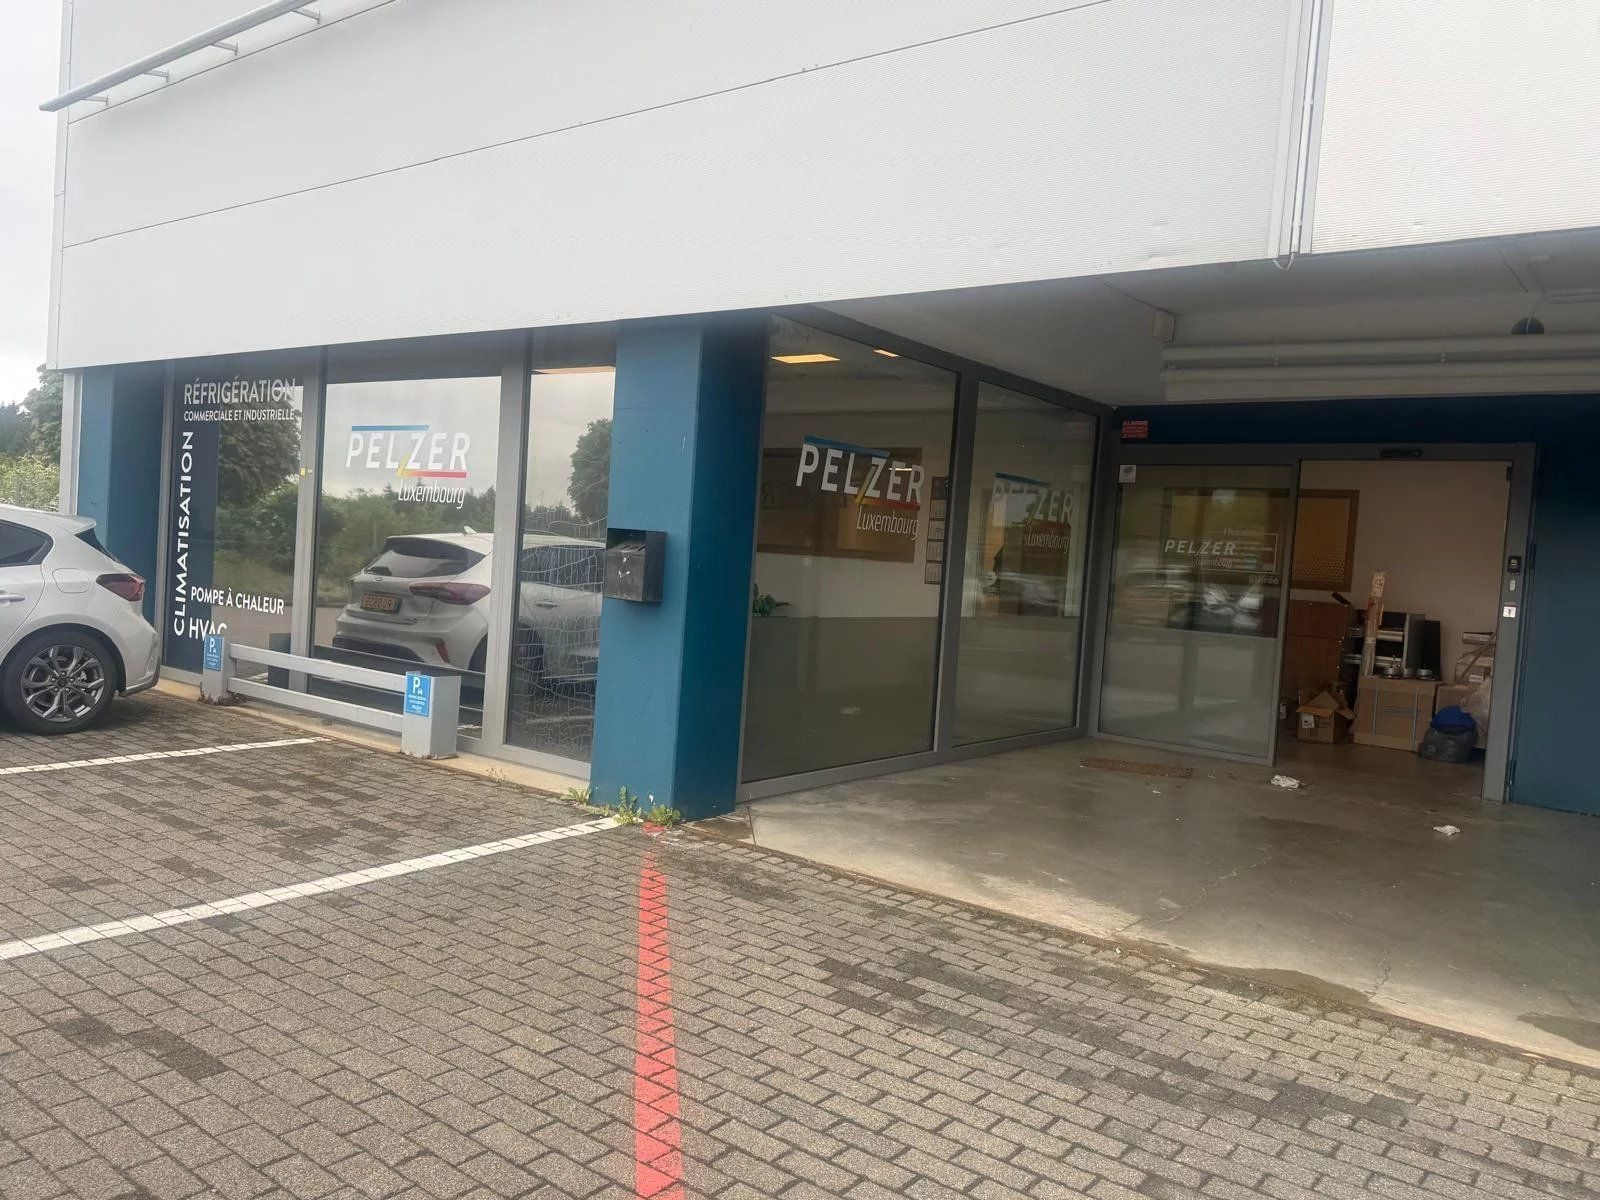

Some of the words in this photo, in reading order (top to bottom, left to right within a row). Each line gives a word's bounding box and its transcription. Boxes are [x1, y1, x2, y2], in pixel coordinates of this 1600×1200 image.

[184, 375, 296, 404] RÉFRIGÉRATION
[183, 410, 233, 422] COMMERCIALE
[233, 410, 242, 421] ET
[243, 408, 295, 421] INDUSTRIELLE
[345, 432, 471, 471] PELZER
[795, 443, 925, 505] PELZER
[398, 479, 465, 509] Luxembourg
[991, 480, 1073, 525] PZER
[174, 431, 194, 636] CLIMATISATION
[856, 505, 920, 541] Luxembourg
[1164, 539, 1237, 556] PELZER
[191, 586, 225, 606] POMPE
[226, 587, 233, 607] À
[235, 593, 285, 615] CHALEUR
